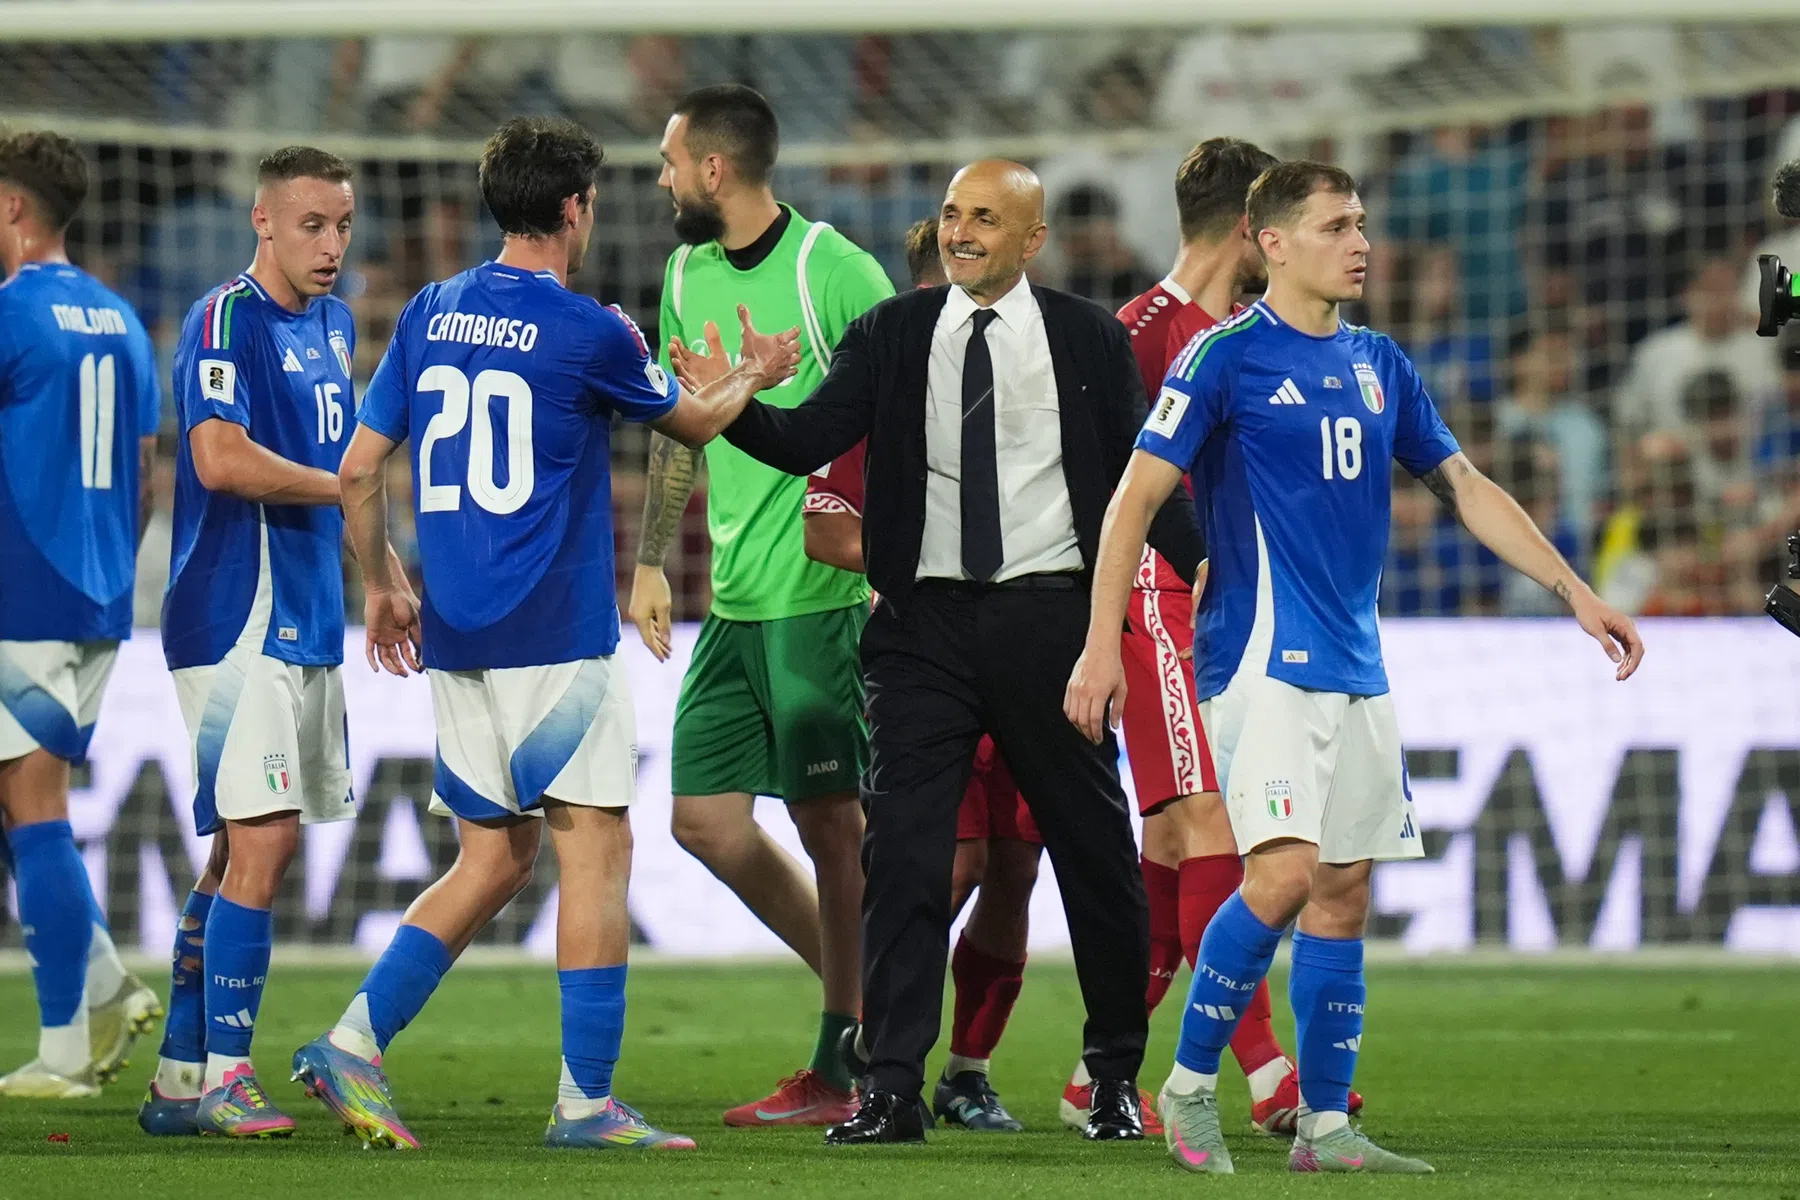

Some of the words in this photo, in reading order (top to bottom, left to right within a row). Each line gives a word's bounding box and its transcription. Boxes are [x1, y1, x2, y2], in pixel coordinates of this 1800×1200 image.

[427, 312, 538, 352] CAMBIASO
[80, 353, 115, 490] 11
[314, 382, 344, 444] 16
[416, 364, 535, 515] 20
[1320, 416, 1362, 480] 18
[266, 761, 285, 770] ITALIA
[807, 759, 839, 777] JAKO
[214, 974, 265, 989] ITALIA
[1149, 967, 1177, 980] JA
[1202, 964, 1256, 991] ITALIA
[1328, 1001, 1365, 1015] ITAL
